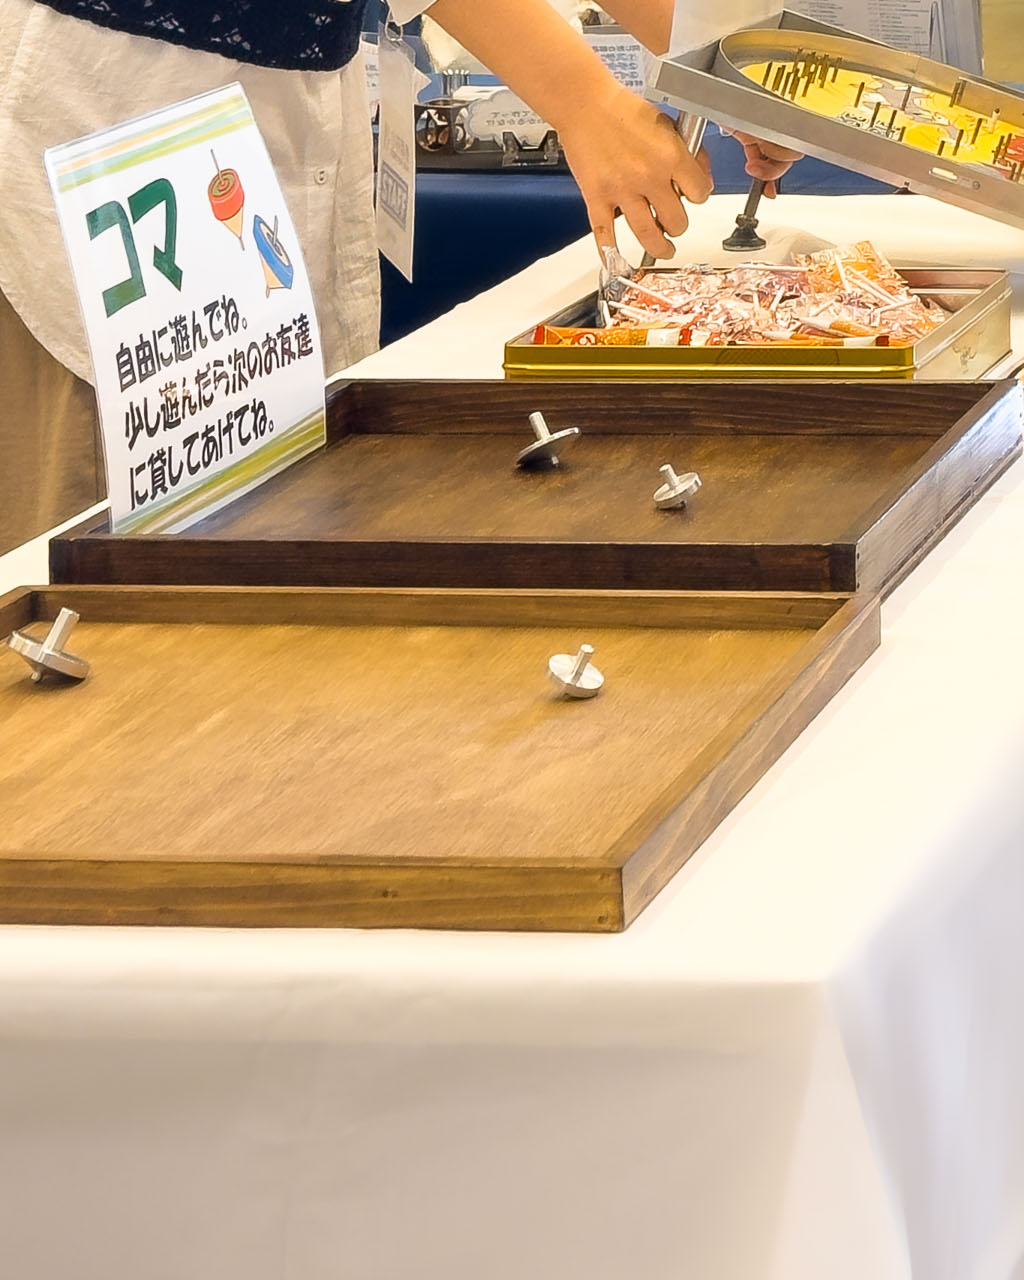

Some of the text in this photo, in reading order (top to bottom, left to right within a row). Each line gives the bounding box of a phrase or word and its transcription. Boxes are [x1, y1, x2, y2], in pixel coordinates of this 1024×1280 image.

[86, 177, 183, 319] コマ
[115, 294, 248, 393] 自由に遊んでね。
[125, 312, 314, 451] 少し遊んだら次のお友達
[130, 397, 274, 511] に貸してあげてね。
